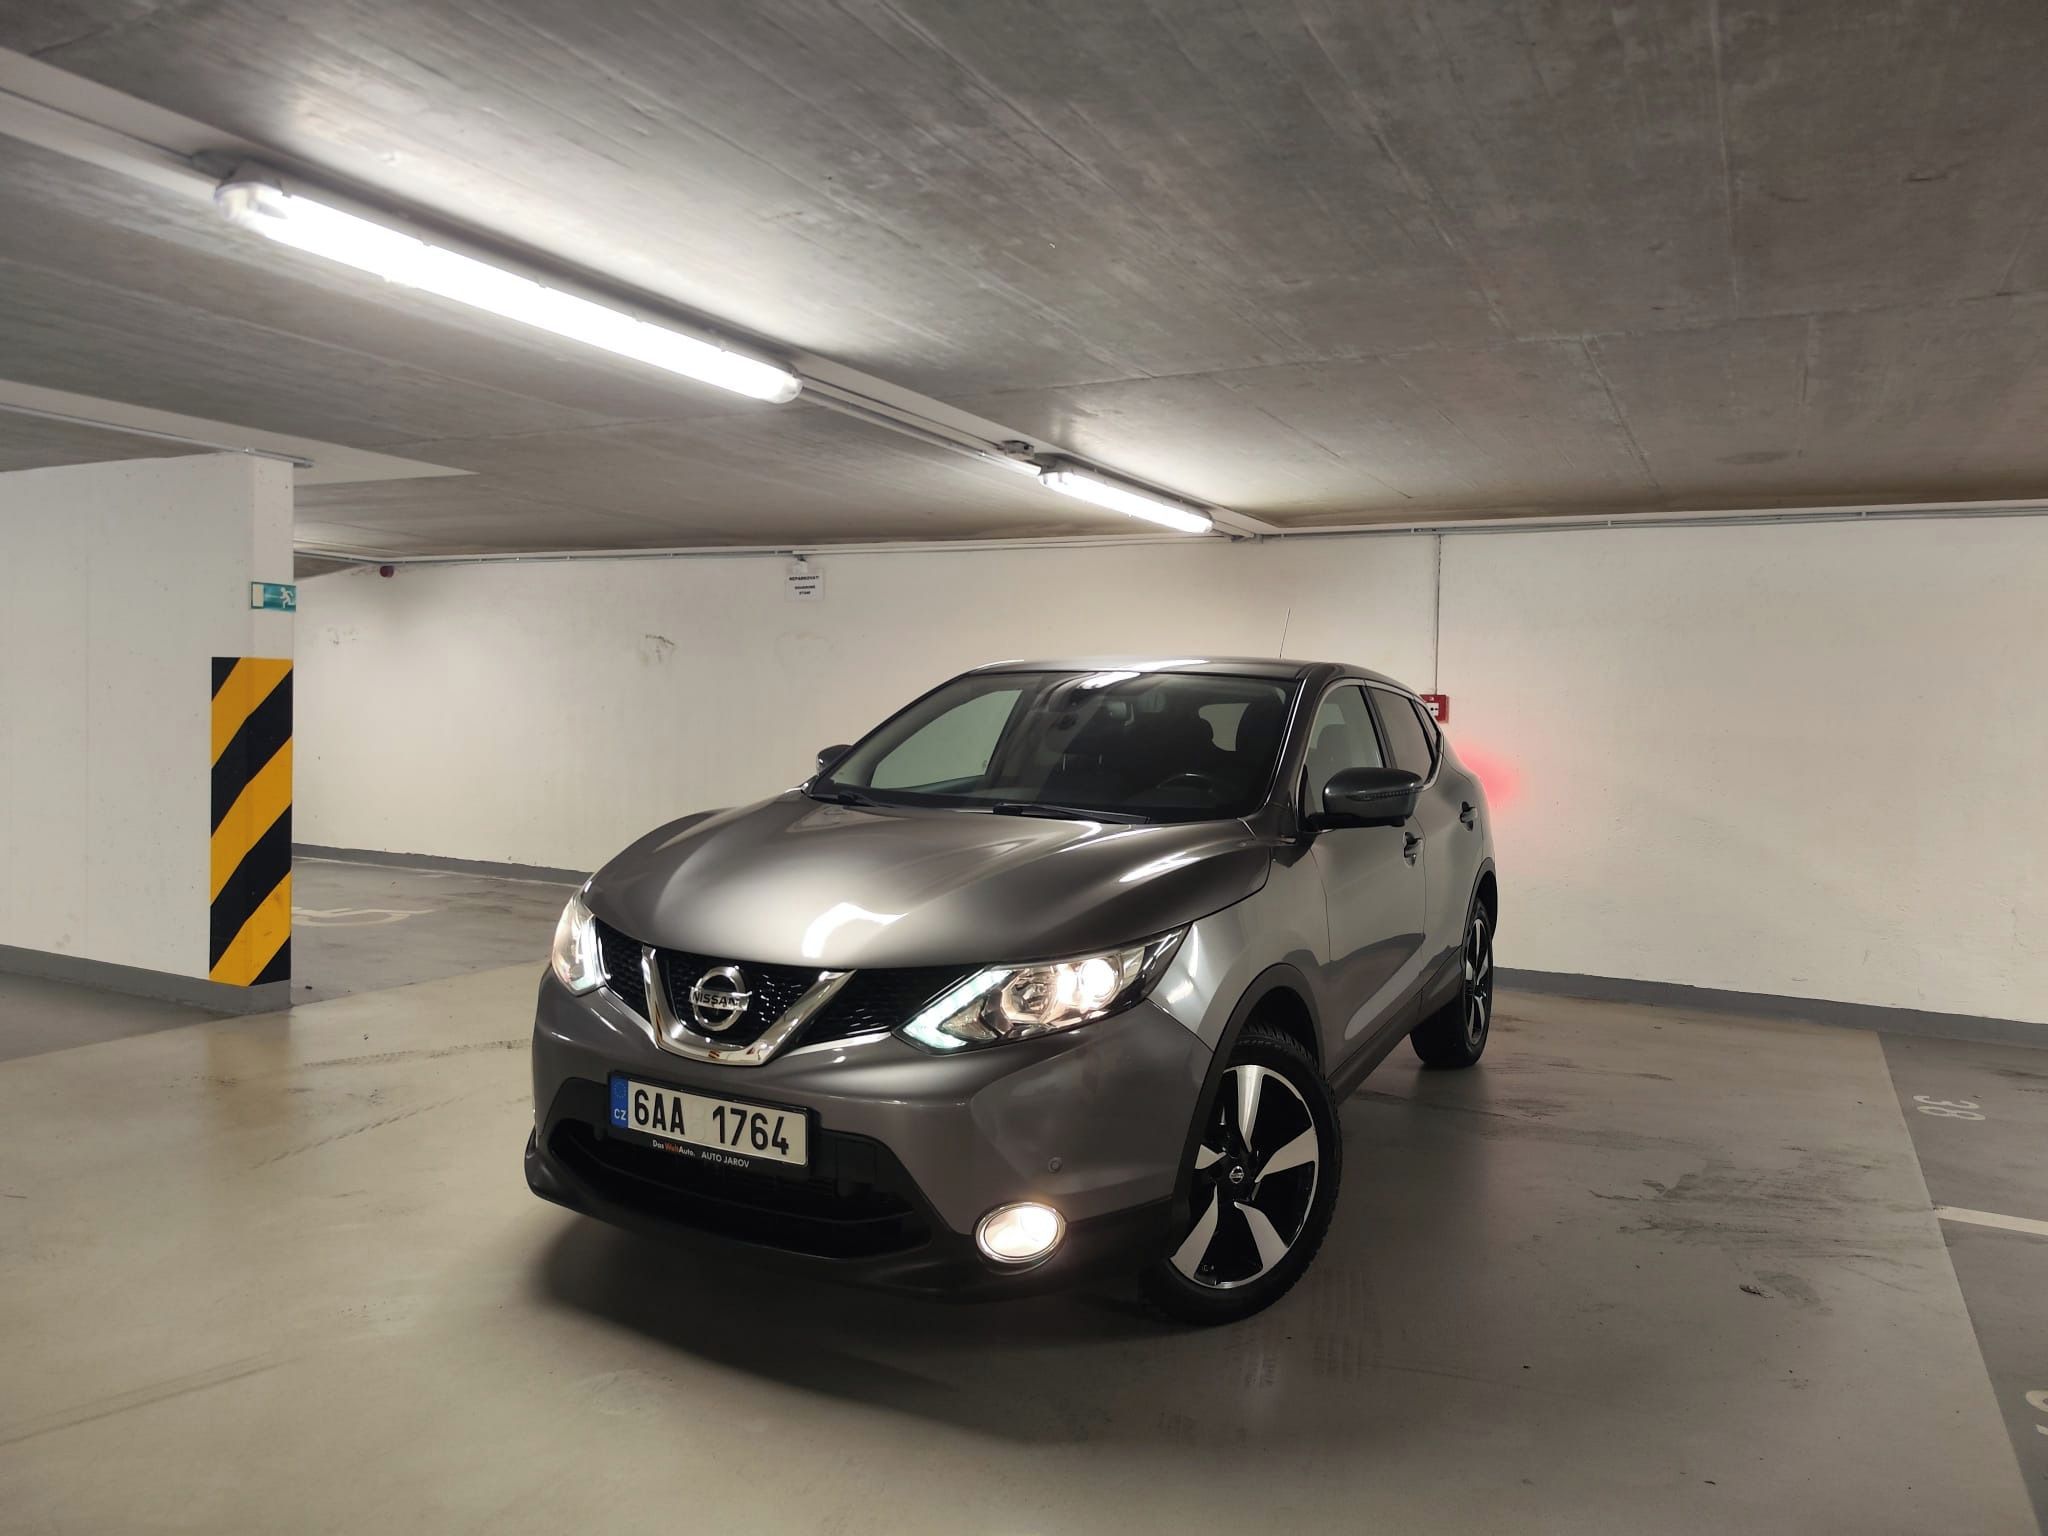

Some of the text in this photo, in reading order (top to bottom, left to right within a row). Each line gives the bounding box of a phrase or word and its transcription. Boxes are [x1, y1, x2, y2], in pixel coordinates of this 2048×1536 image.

[693, 992, 740, 1007] NISSAN
[614, 1108, 627, 1121] CZ
[634, 1089, 790, 1155] 6AA 1764
[652, 1139, 665, 1150] Das
[701, 1151, 723, 1163] AUTO
[723, 1153, 750, 1168] JAROV
